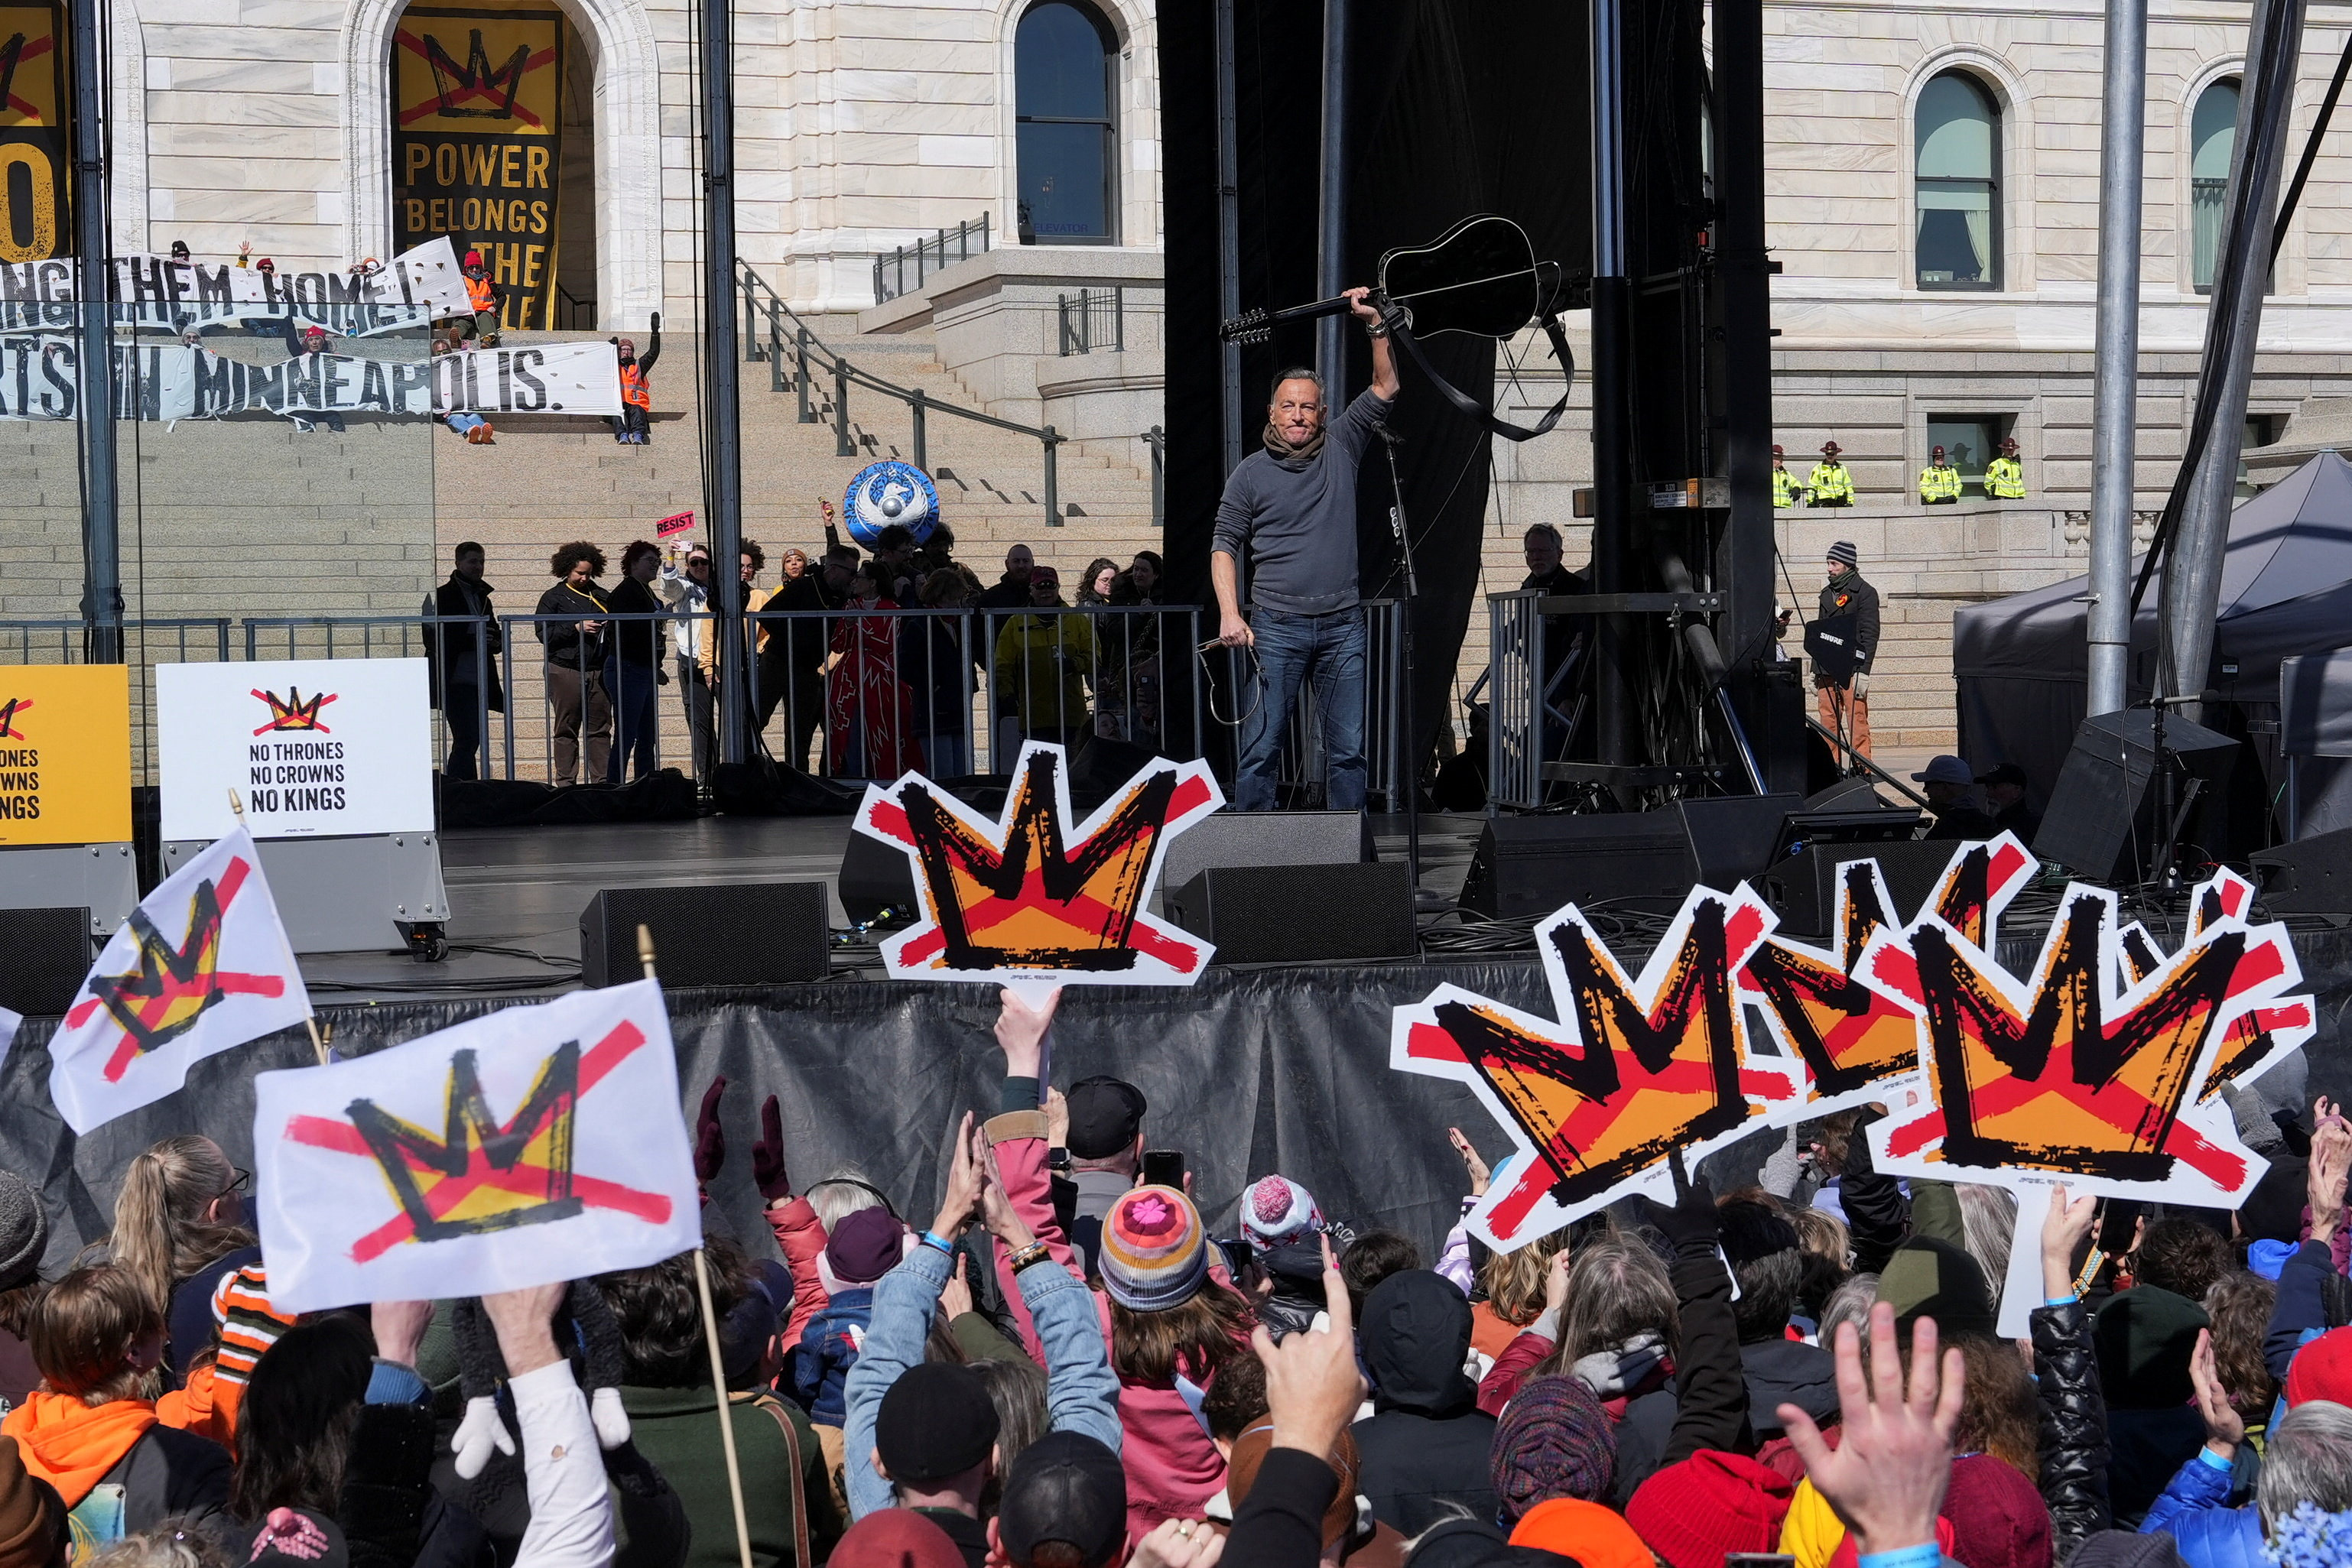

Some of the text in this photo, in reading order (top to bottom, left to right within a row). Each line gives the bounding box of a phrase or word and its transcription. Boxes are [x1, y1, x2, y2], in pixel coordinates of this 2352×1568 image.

[405, 142, 550, 189] POWER
[407, 197, 549, 234] BELONGS
[1034, 222, 1088, 232] ELEVATOR
[0, 262, 73, 329] NG
[262, 261, 417, 335] HOME!
[193, 342, 564, 415] MINNEAPOLIS.
[657, 513, 694, 534] RESIST
[1820, 631, 1844, 646] SHURE
[250, 742, 344, 761] NO THRONES
[251, 765, 345, 785] NO CROWNS
[252, 787, 346, 813] NO KINGS
